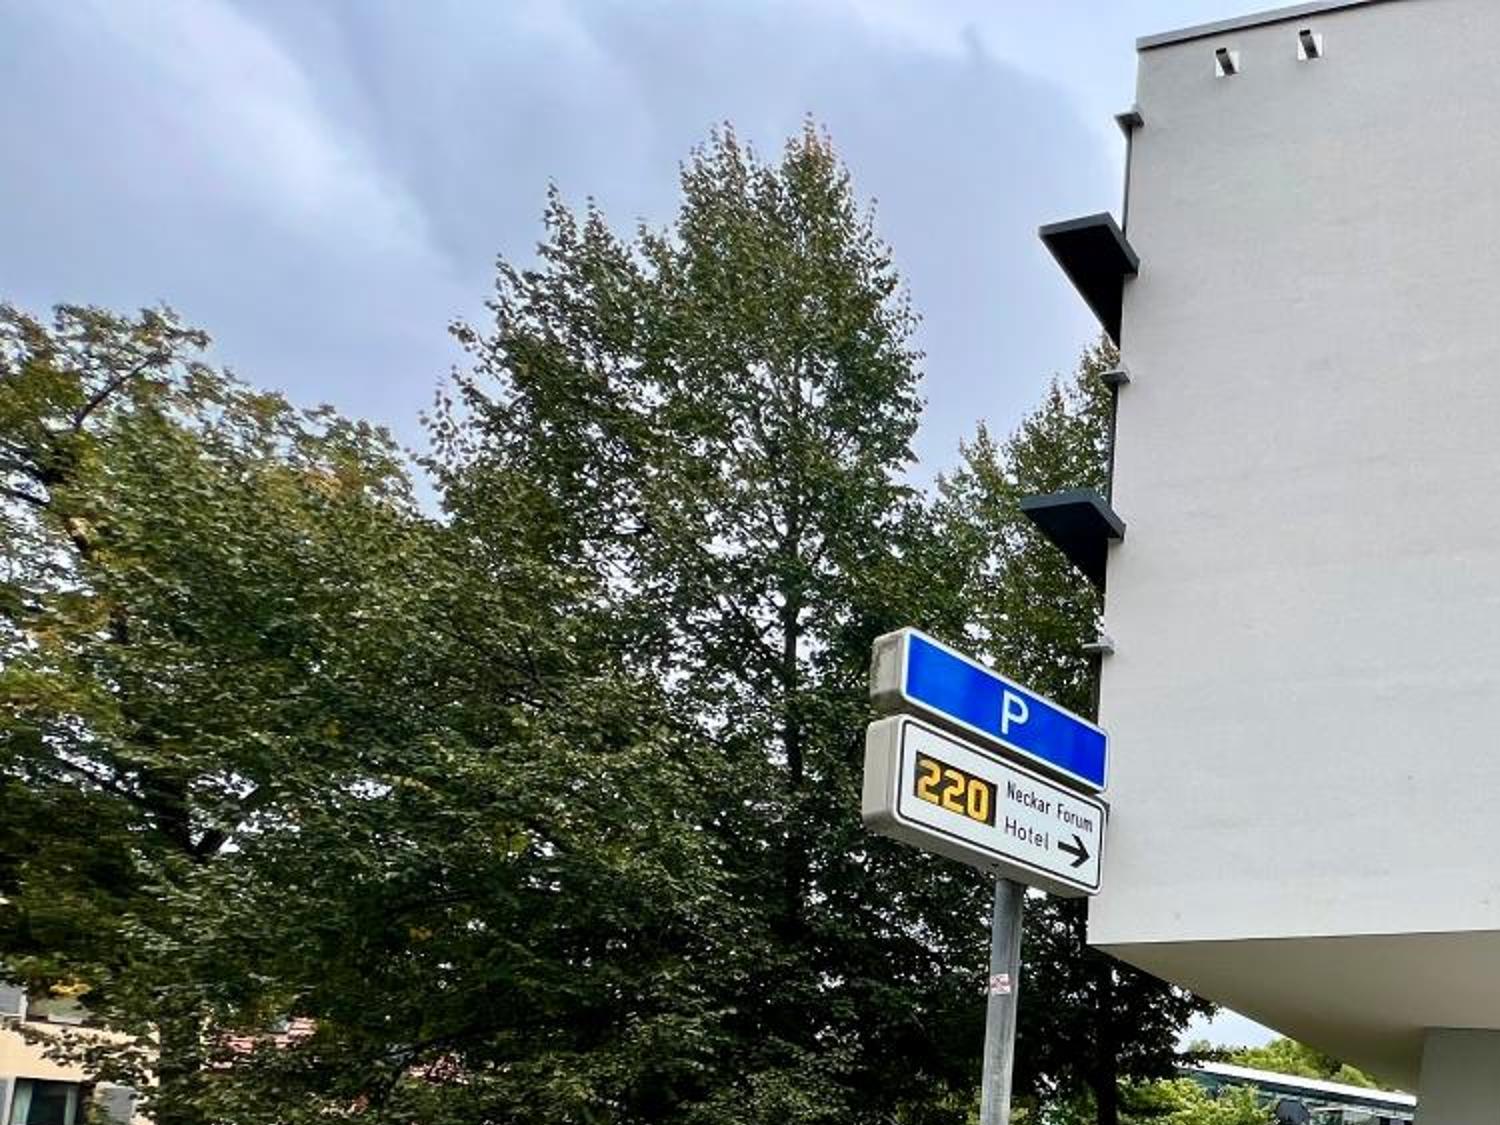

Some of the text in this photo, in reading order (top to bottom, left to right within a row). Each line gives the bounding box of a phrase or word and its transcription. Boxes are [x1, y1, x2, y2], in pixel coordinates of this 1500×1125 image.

[1001, 689, 1030, 735] P
[916, 759, 989, 822] 220
[1006, 780, 1094, 834] Neckar Forum
[1003, 816, 1050, 850] Hotel
